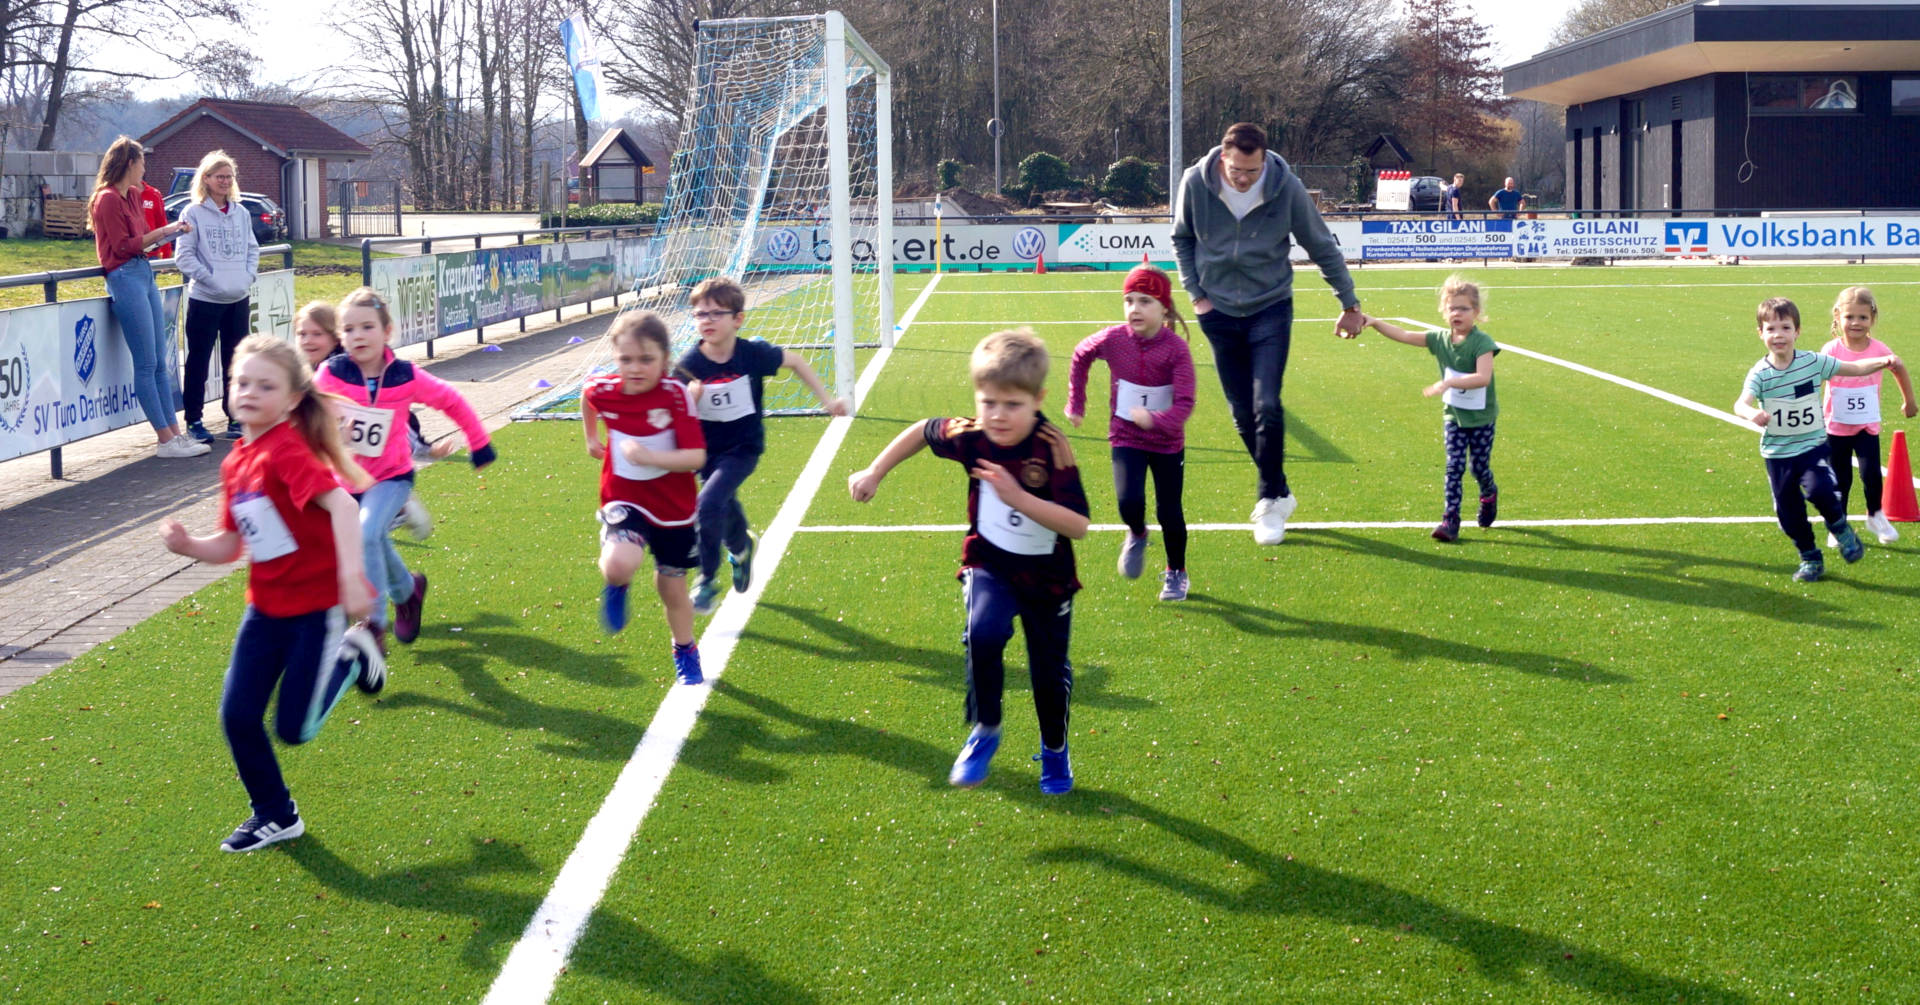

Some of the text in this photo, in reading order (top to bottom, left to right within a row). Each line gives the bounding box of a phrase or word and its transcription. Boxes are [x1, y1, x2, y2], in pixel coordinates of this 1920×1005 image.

[1390, 221, 1486, 233] TAXI GILANI
[1572, 221, 1638, 234] GILANI
[1100, 235, 1155, 248] LOMA
[1415, 234, 1437, 243] 500
[1485, 234, 1506, 243] 500
[1553, 237, 1657, 246] ARBEITSSCHUTZ
[1721, 222, 1920, 248] Volksbank Ba
[439, 253, 486, 303] Kreuziger
[3, 399, 20, 413] JAHRE
[710, 392, 731, 406] 61
[1141, 394, 1148, 407] 1
[1847, 397, 1866, 410] 55
[34, 402, 50, 435] SV
[53, 400, 76, 430] Turo
[79, 384, 118, 422] Darfeld
[1772, 406, 1815, 428] 155
[337, 416, 384, 447] 56
[1008, 509, 1022, 527] 6
